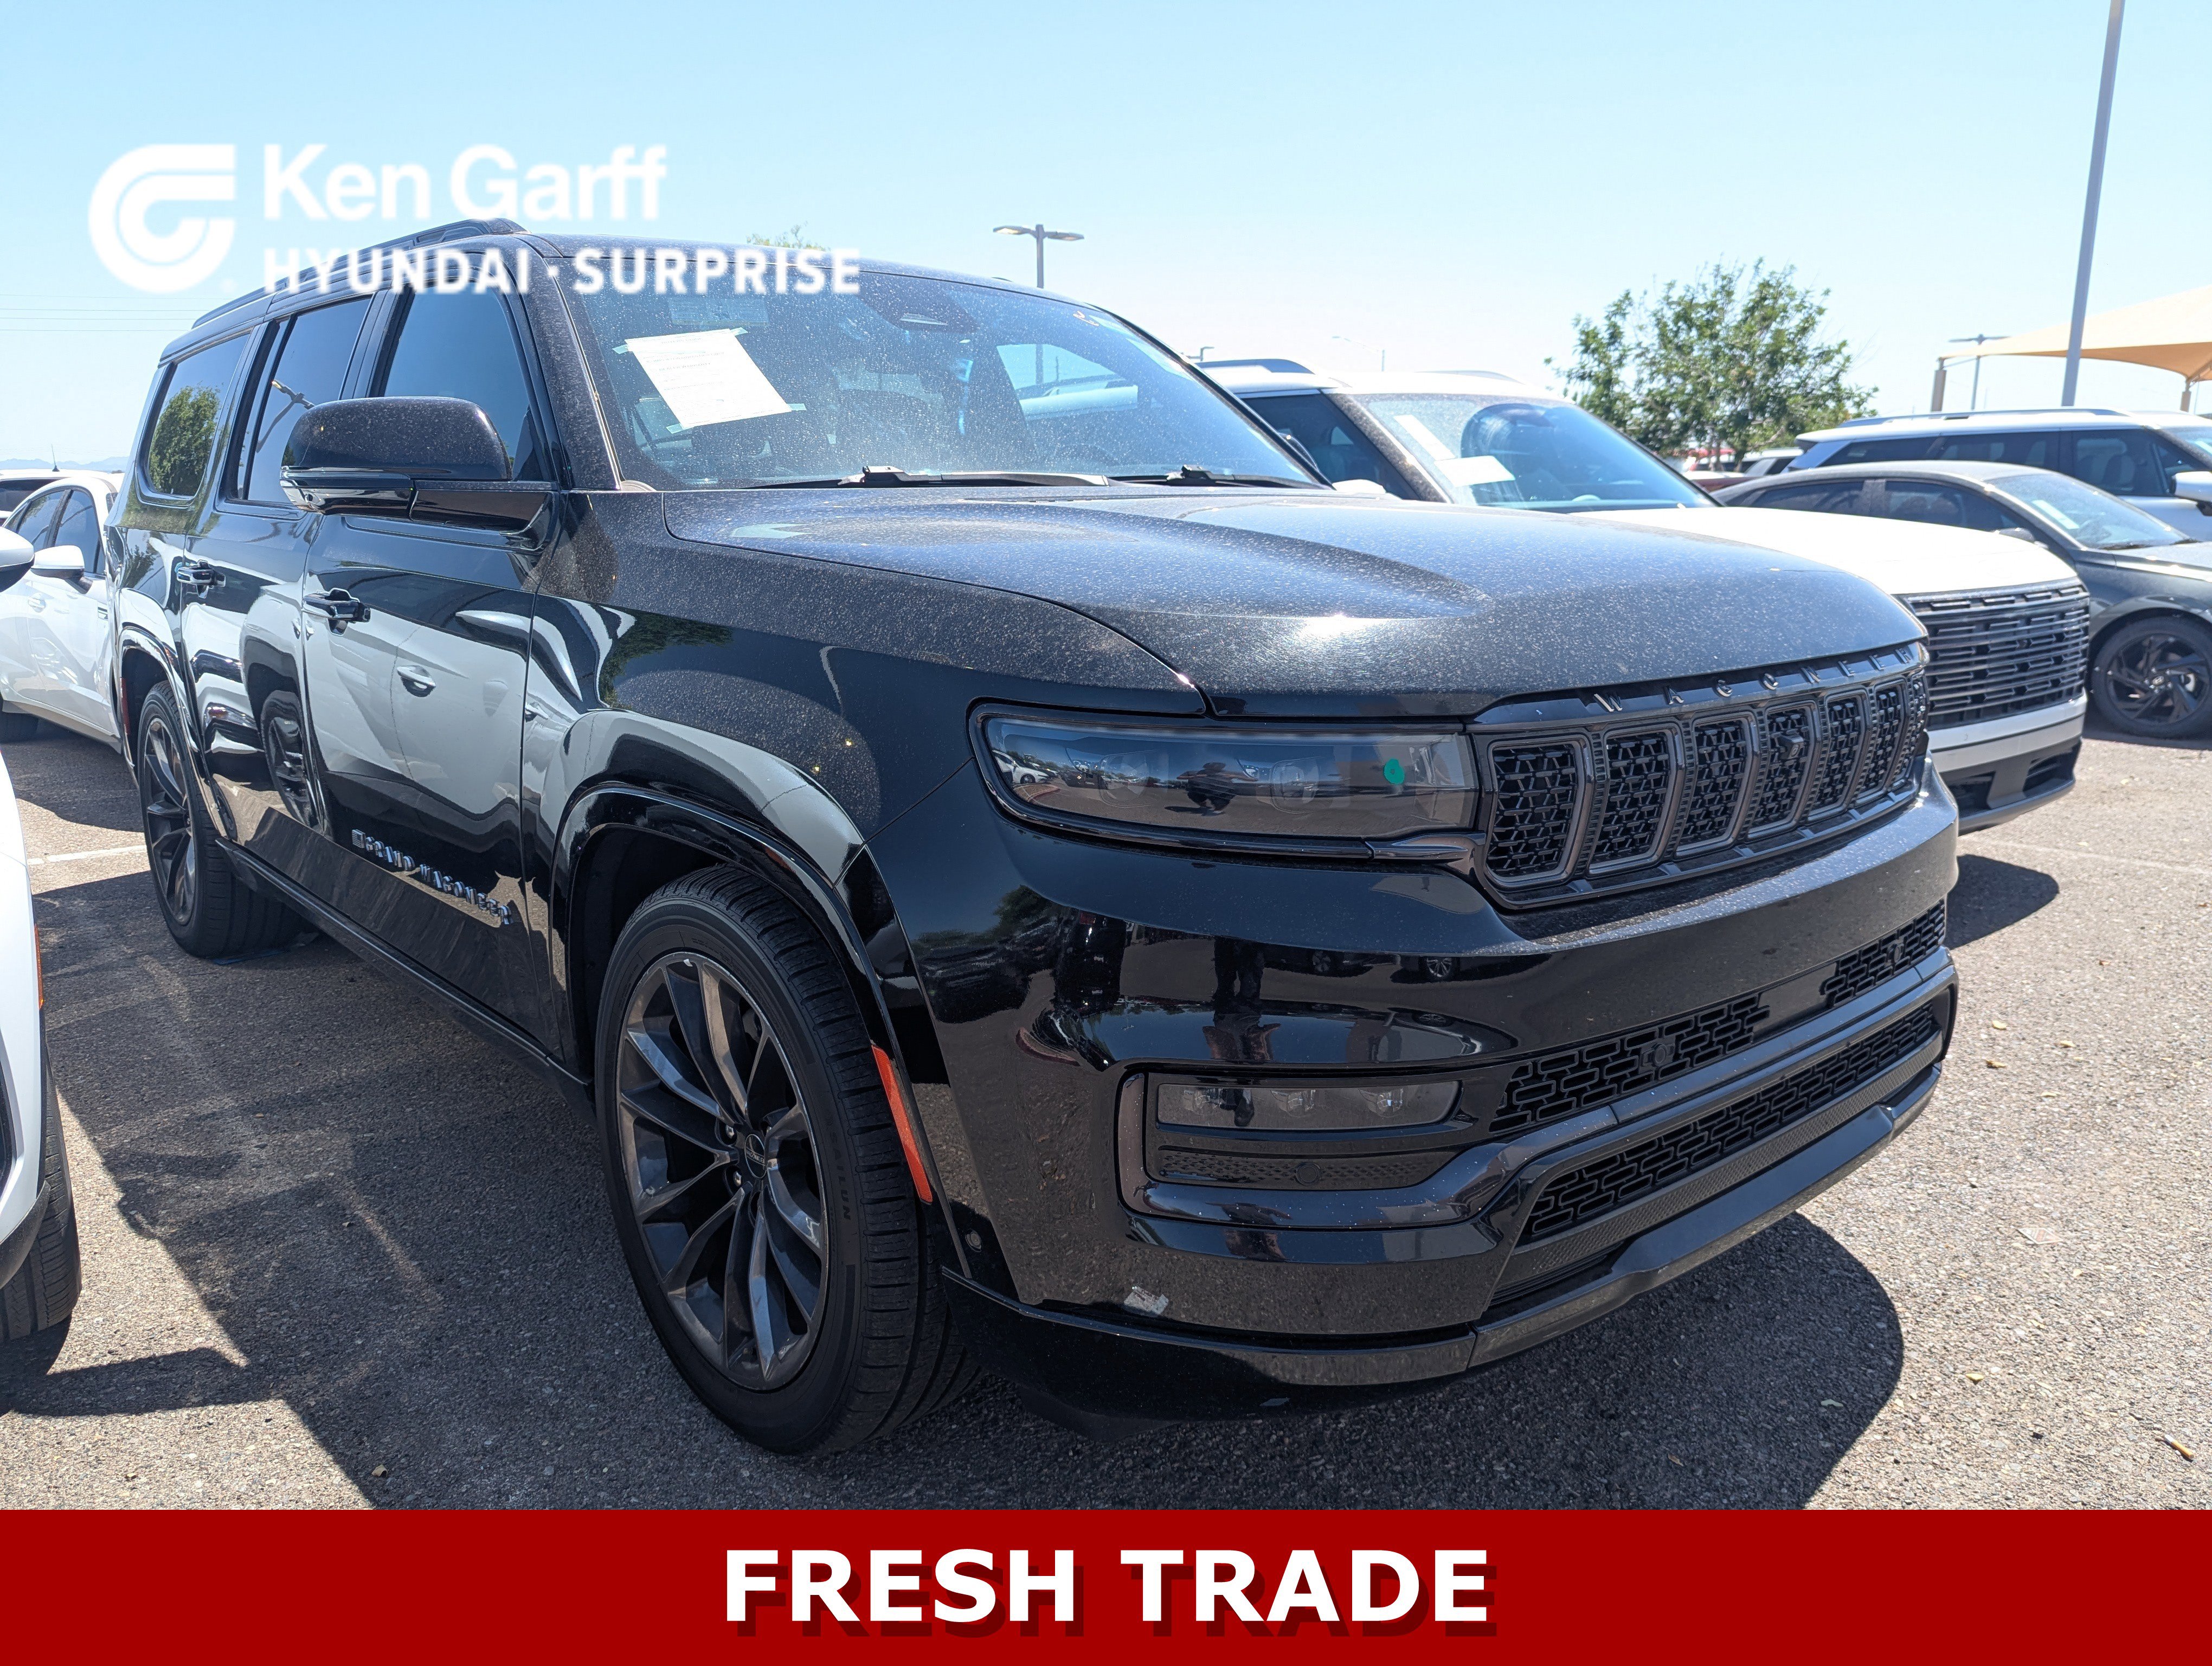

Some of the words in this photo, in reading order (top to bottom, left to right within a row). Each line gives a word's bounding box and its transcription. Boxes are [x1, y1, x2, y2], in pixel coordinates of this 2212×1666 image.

[1593, 647, 1914, 712] WAGONEER
[365, 836, 416, 871] GRAND
[419, 863, 515, 925] WAGONEER
